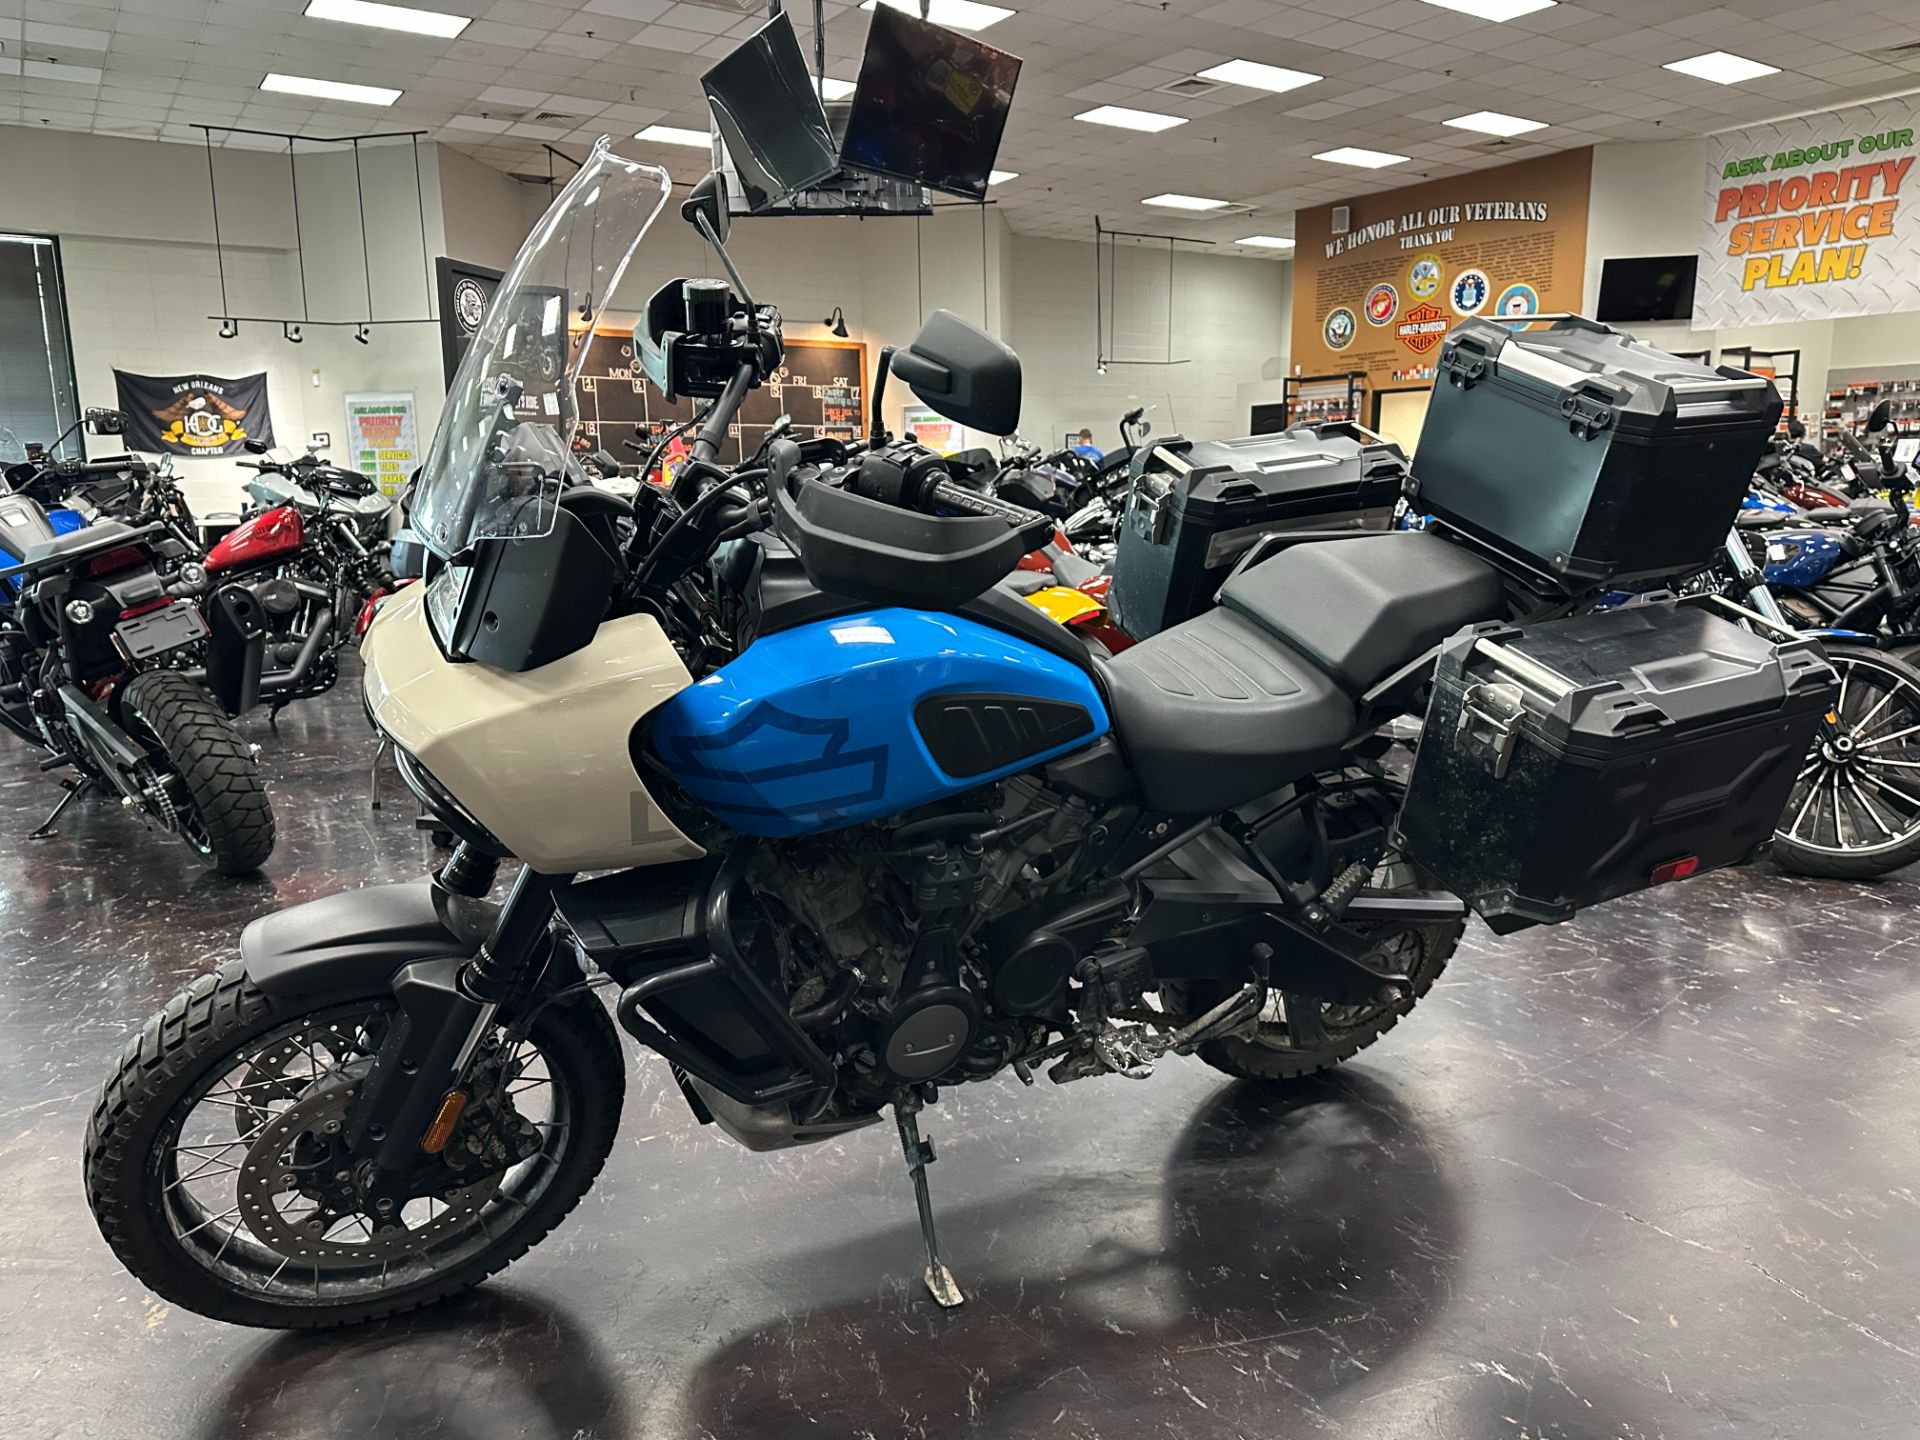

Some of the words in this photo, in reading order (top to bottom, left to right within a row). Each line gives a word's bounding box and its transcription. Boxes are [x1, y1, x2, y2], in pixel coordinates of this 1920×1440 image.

[1722, 155, 1768, 179] ASK
[1770, 140, 1854, 171] ABOUT
[1859, 128, 1914, 154] OUR
[1715, 156, 1917, 222] PRIORITY
[1325, 237, 1345, 259] WE
[1347, 219, 1395, 250] HONOR
[1399, 211, 1426, 232] ALL
[1428, 205, 1461, 226] OUR
[1465, 201, 1547, 222] VETERANS
[1400, 232, 1433, 249] THANK
[1435, 228, 1456, 244] YOU
[1727, 200, 1900, 256] SERVICE
[1742, 244, 1867, 292] PLAN!
[1410, 309, 1436, 321] MOTOR
[1399, 321, 1448, 336] HARLEY-DAVIDSON
[172, 382, 189, 394] NEW
[191, 380, 224, 395] ORLEANS
[608, 368, 632, 379] MON
[792, 376, 807, 386] FRI
[832, 376, 848, 387] SAT
[191, 446, 223, 456] CHAPTER
